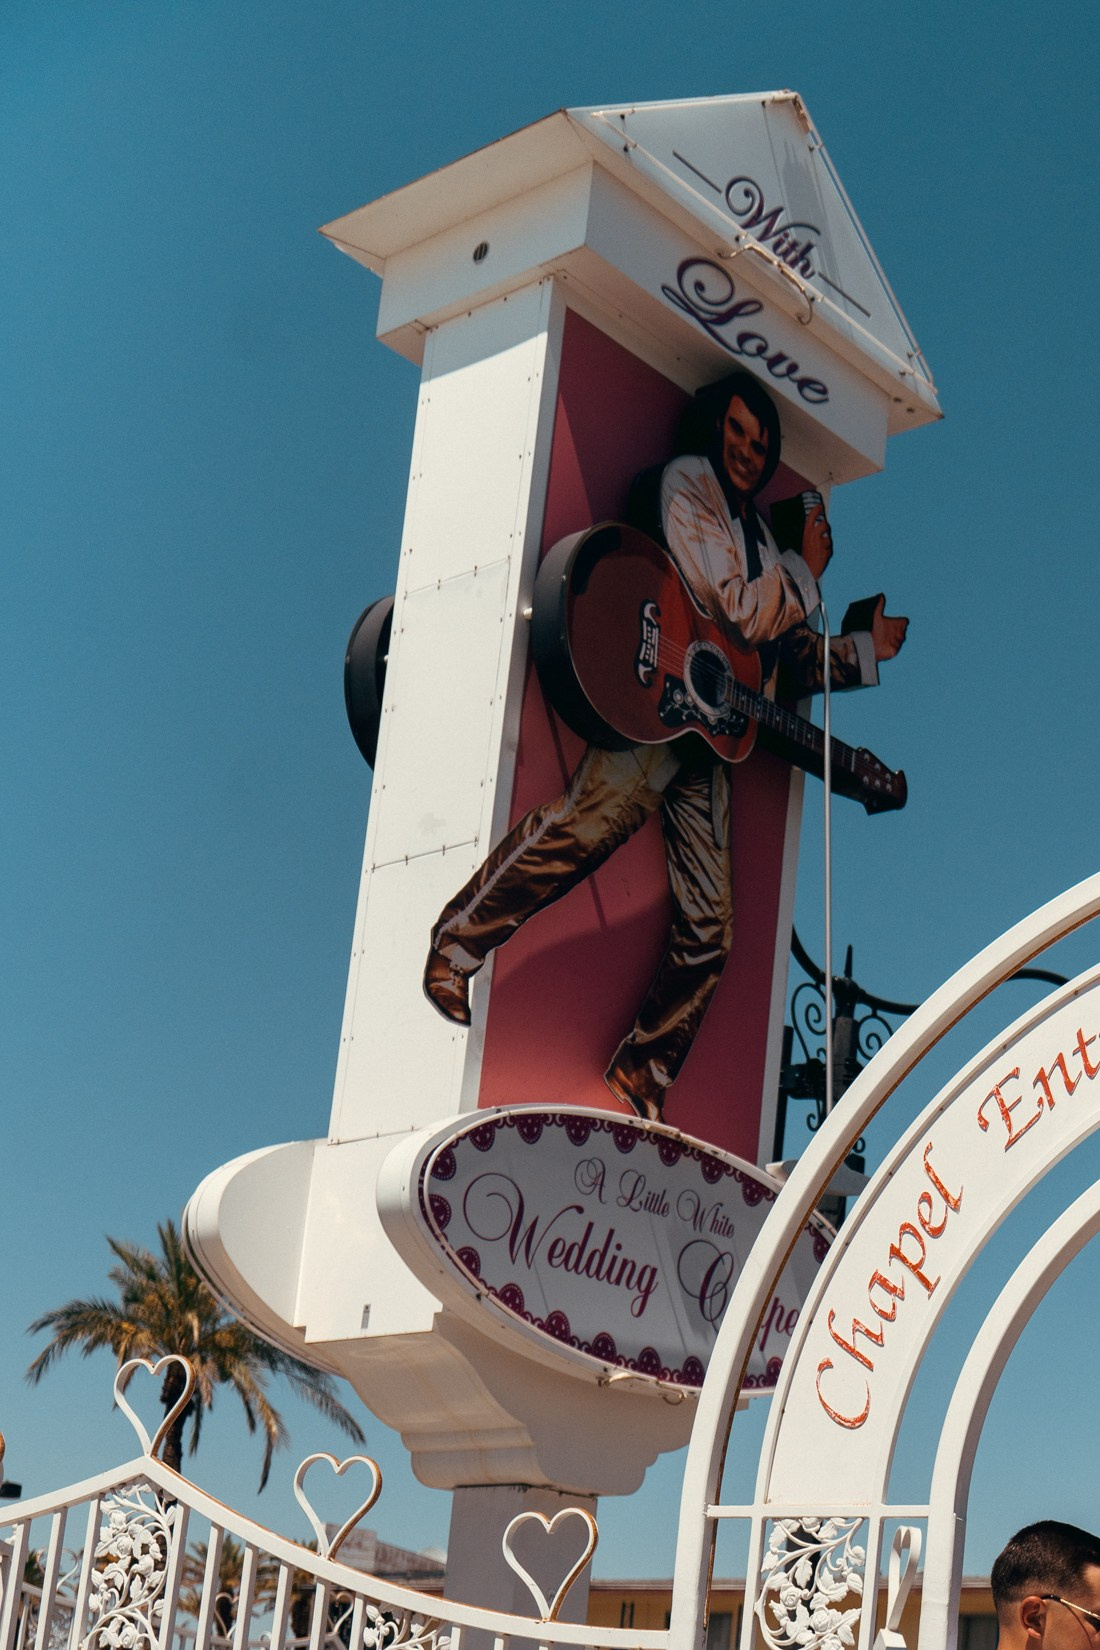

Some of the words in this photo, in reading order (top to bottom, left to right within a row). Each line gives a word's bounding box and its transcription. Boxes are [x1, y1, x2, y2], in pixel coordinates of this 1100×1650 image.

[724, 176, 821, 280] With
[661, 257, 829, 404] Love
[462, 1172, 659, 1318] Wedding
[573, 1156, 609, 1205] A
[616, 1168, 671, 1219] Little
[676, 1188, 736, 1240] White
[815, 1142, 964, 1431] Chapel
